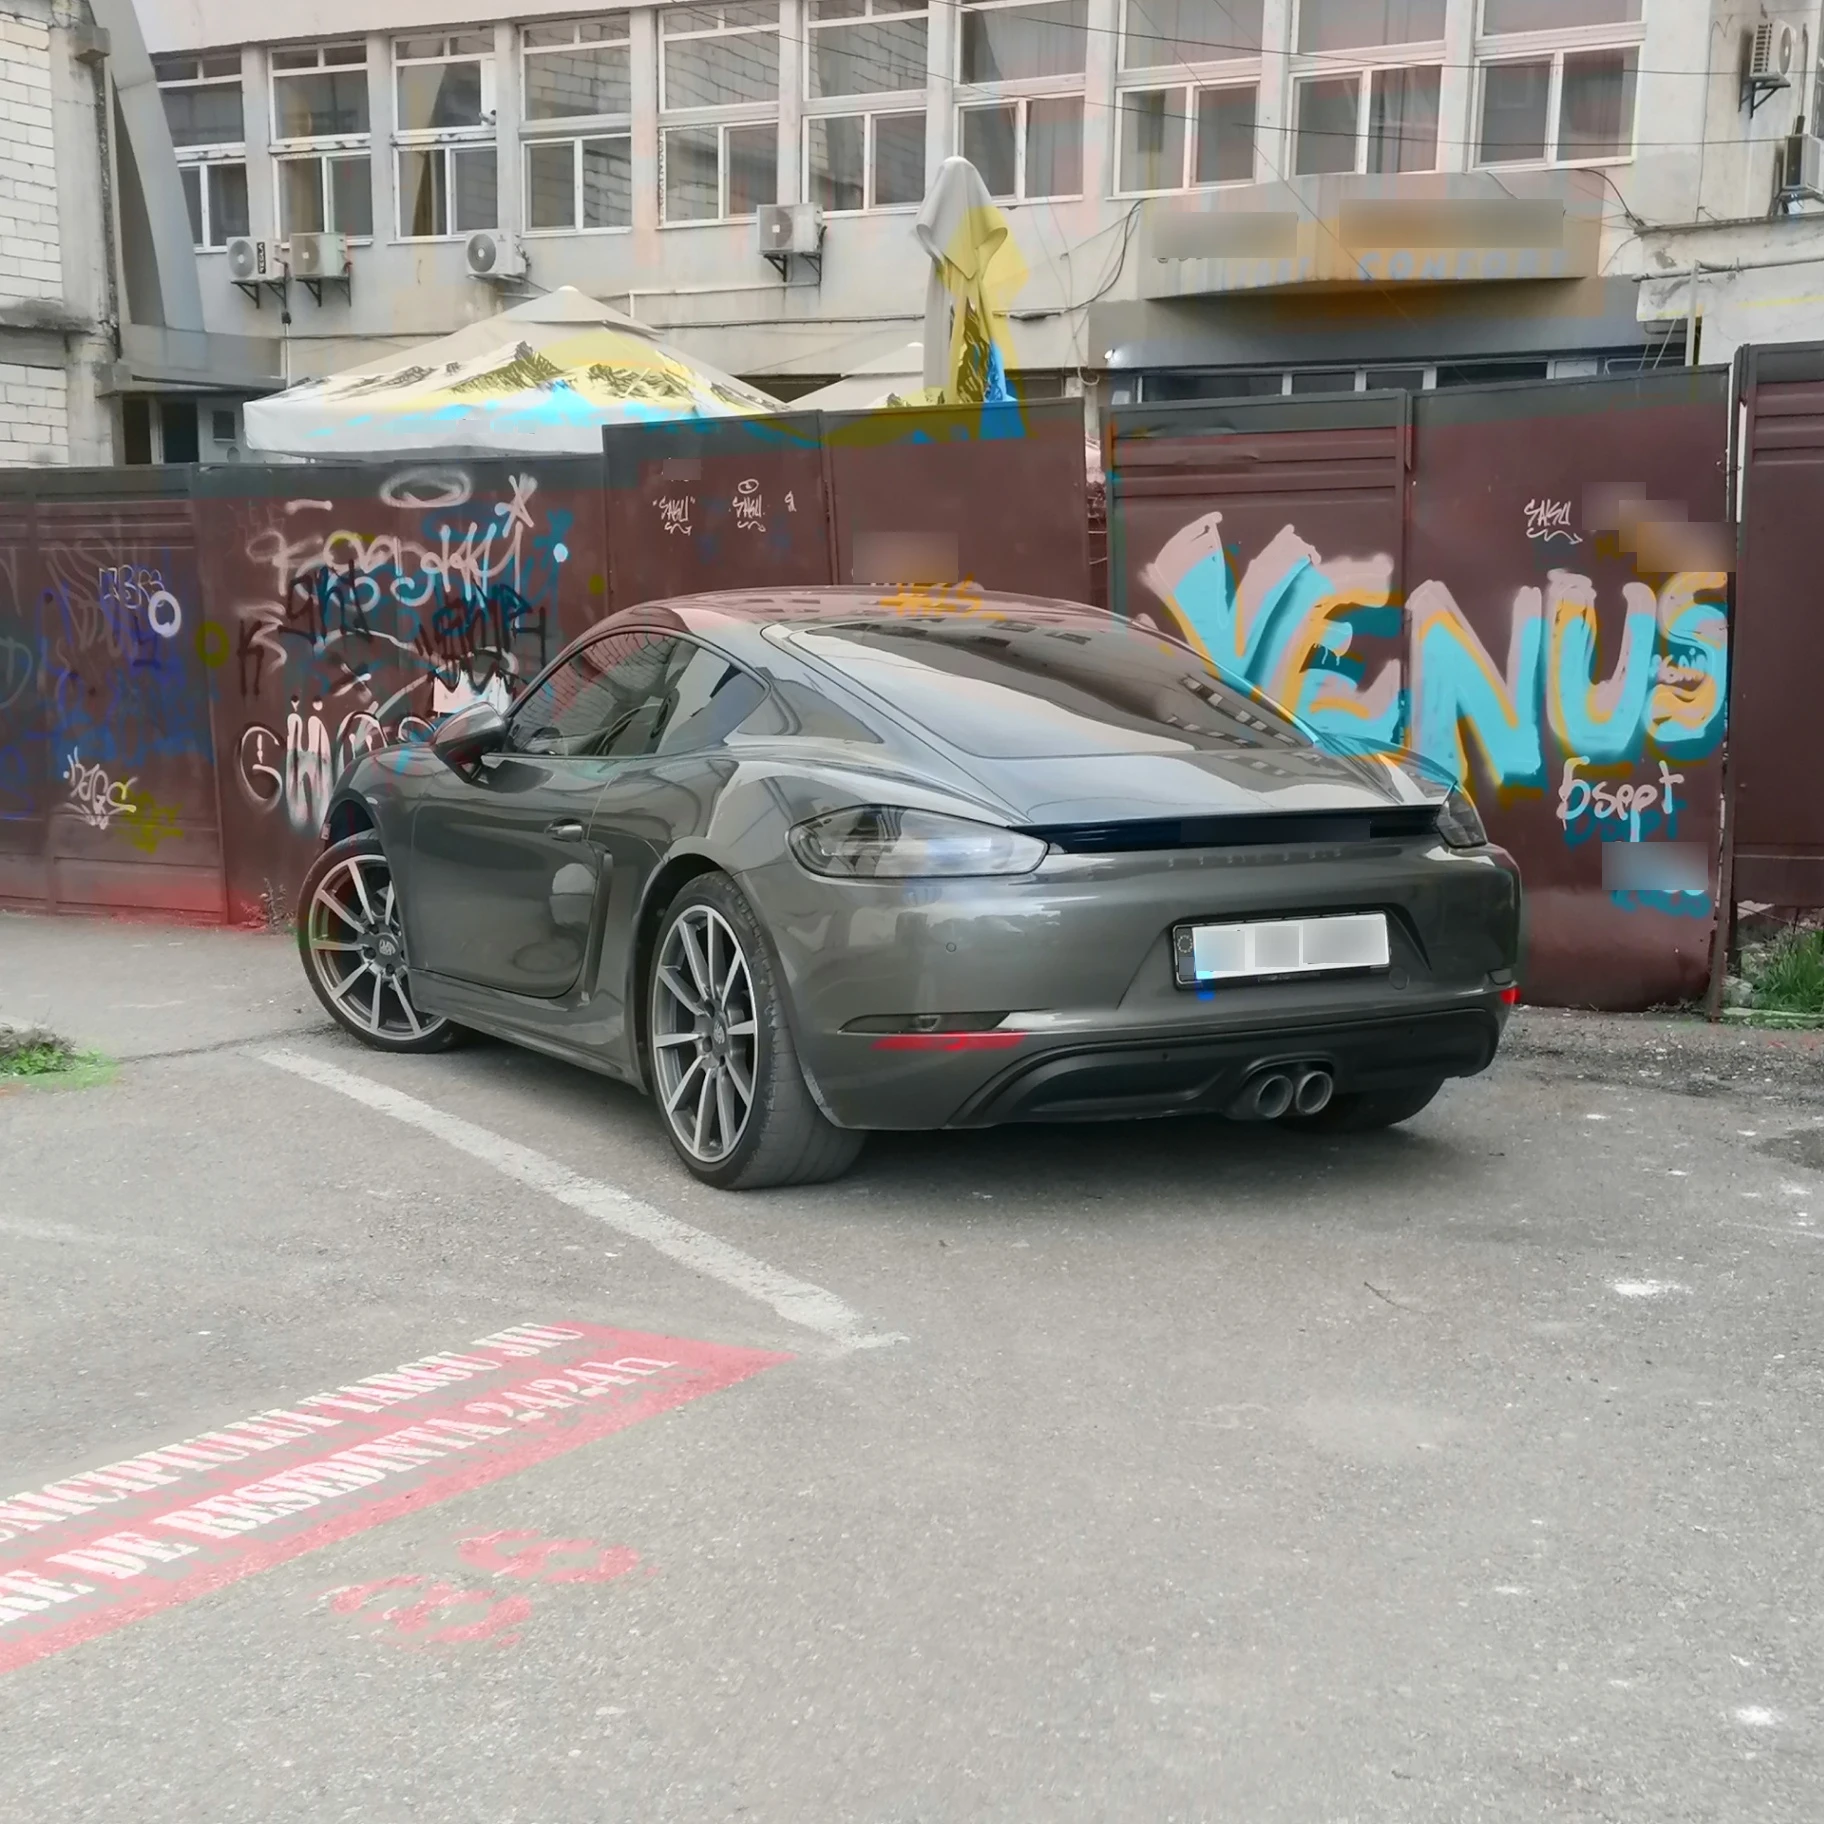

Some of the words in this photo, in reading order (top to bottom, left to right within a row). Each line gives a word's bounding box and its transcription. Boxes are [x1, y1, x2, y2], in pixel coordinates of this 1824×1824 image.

[1139, 511, 1728, 785] VENUS
[470, 1322, 584, 1357] JIU
[45, 1531, 200, 1579] DE
